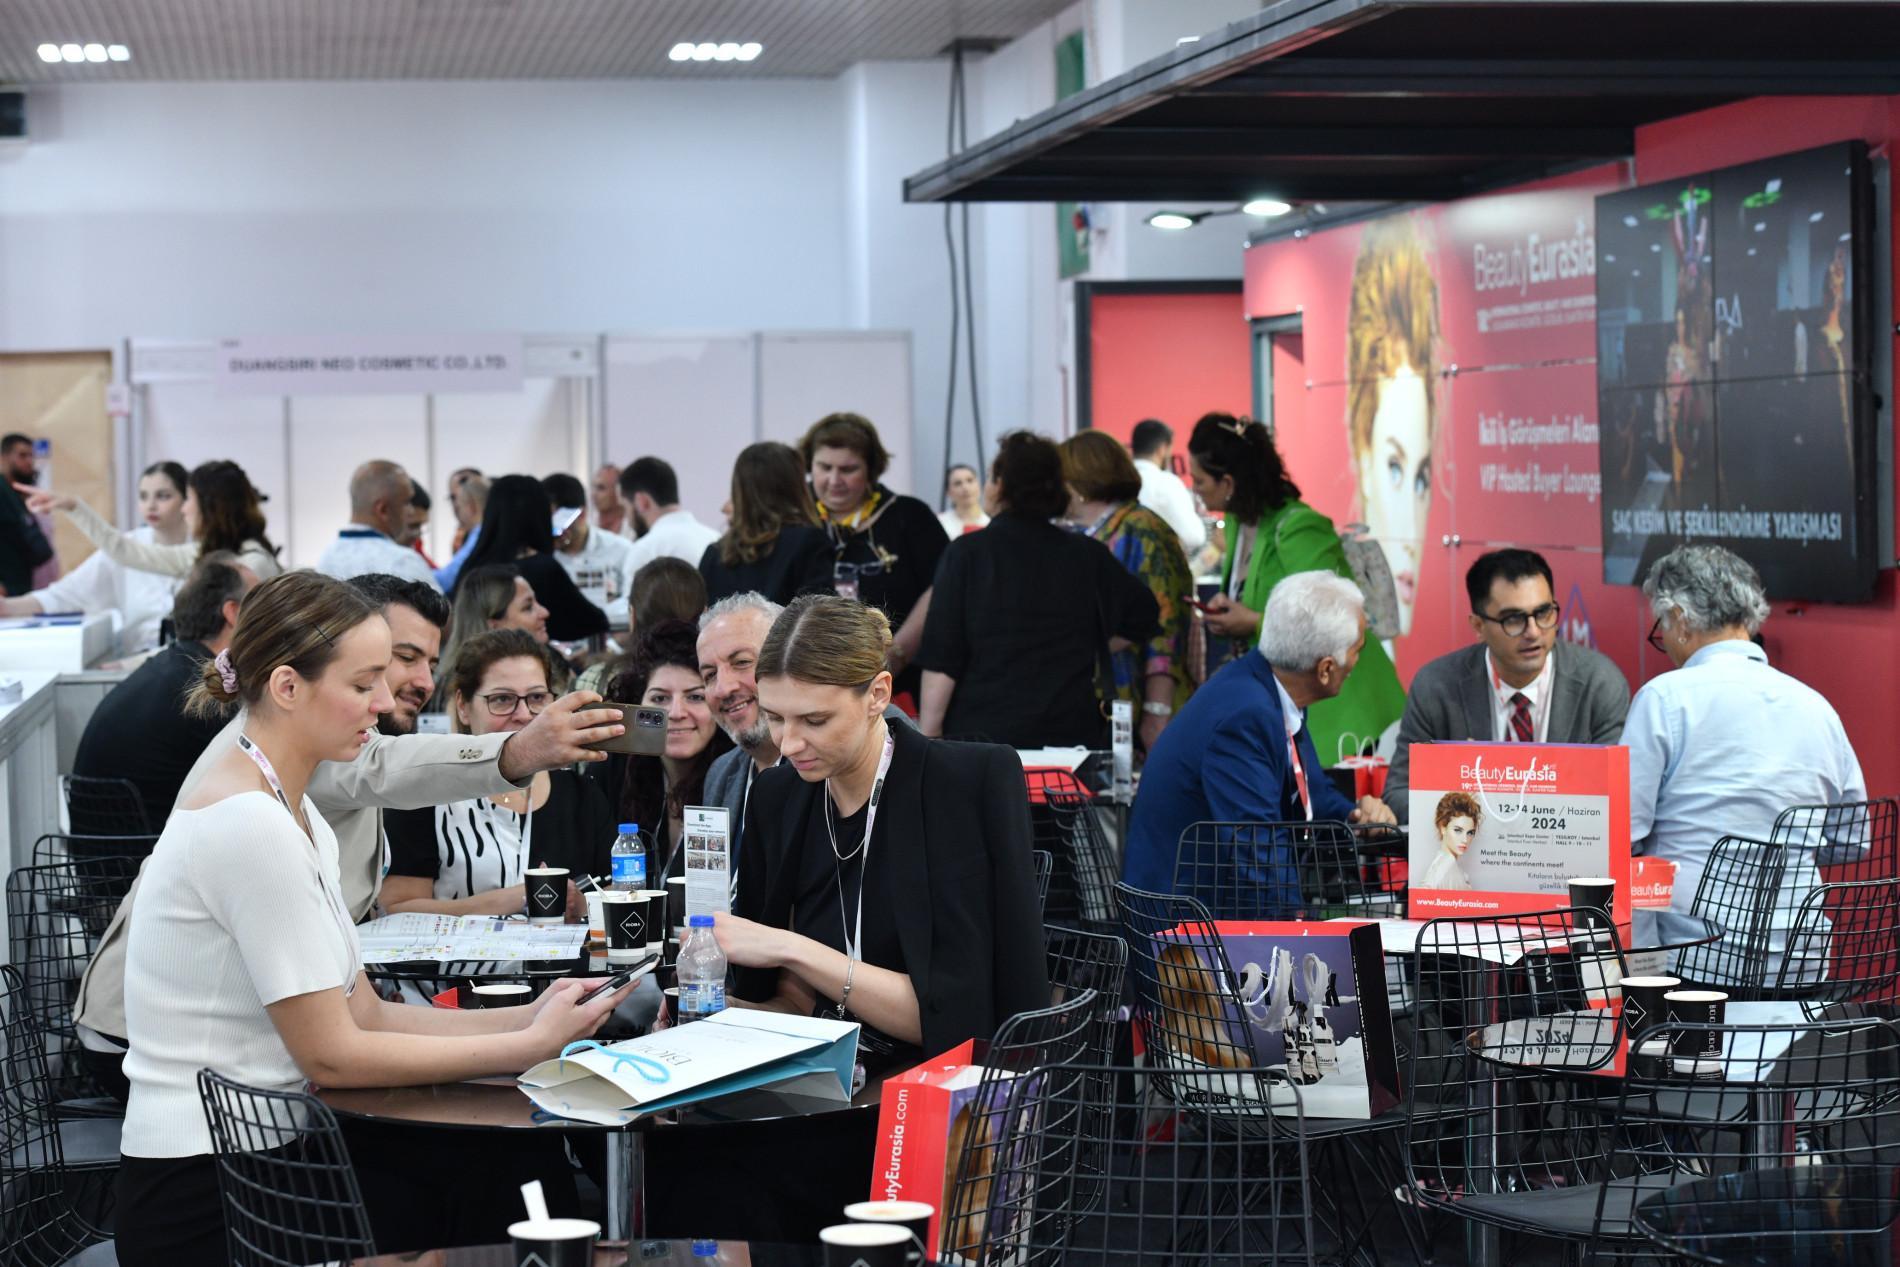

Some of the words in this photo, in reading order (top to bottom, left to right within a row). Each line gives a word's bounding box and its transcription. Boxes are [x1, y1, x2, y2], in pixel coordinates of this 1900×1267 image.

[320, 356, 354, 371] NEO
[358, 355, 438, 371] COSMETIC
[1480, 463, 1496, 491] VIP
[1533, 463, 1563, 502] Buyer
[1612, 509, 1633, 540] SAÇ
[1667, 509, 1682, 535] VE
[1772, 511, 1842, 547] YARIŞMASI
[1460, 763, 1557, 783] BeautyEurasia
[1531, 805, 1556, 815] June
[1567, 807, 1601, 816] Haziran
[1531, 817, 1566, 829] 2024
[1509, 850, 1532, 859] Beauty
[1631, 883, 1672, 898] eautyEura
[1416, 898, 1499, 909] www.BeautyEurasia.com
[885, 1088, 909, 1203] utyEurasia.com
